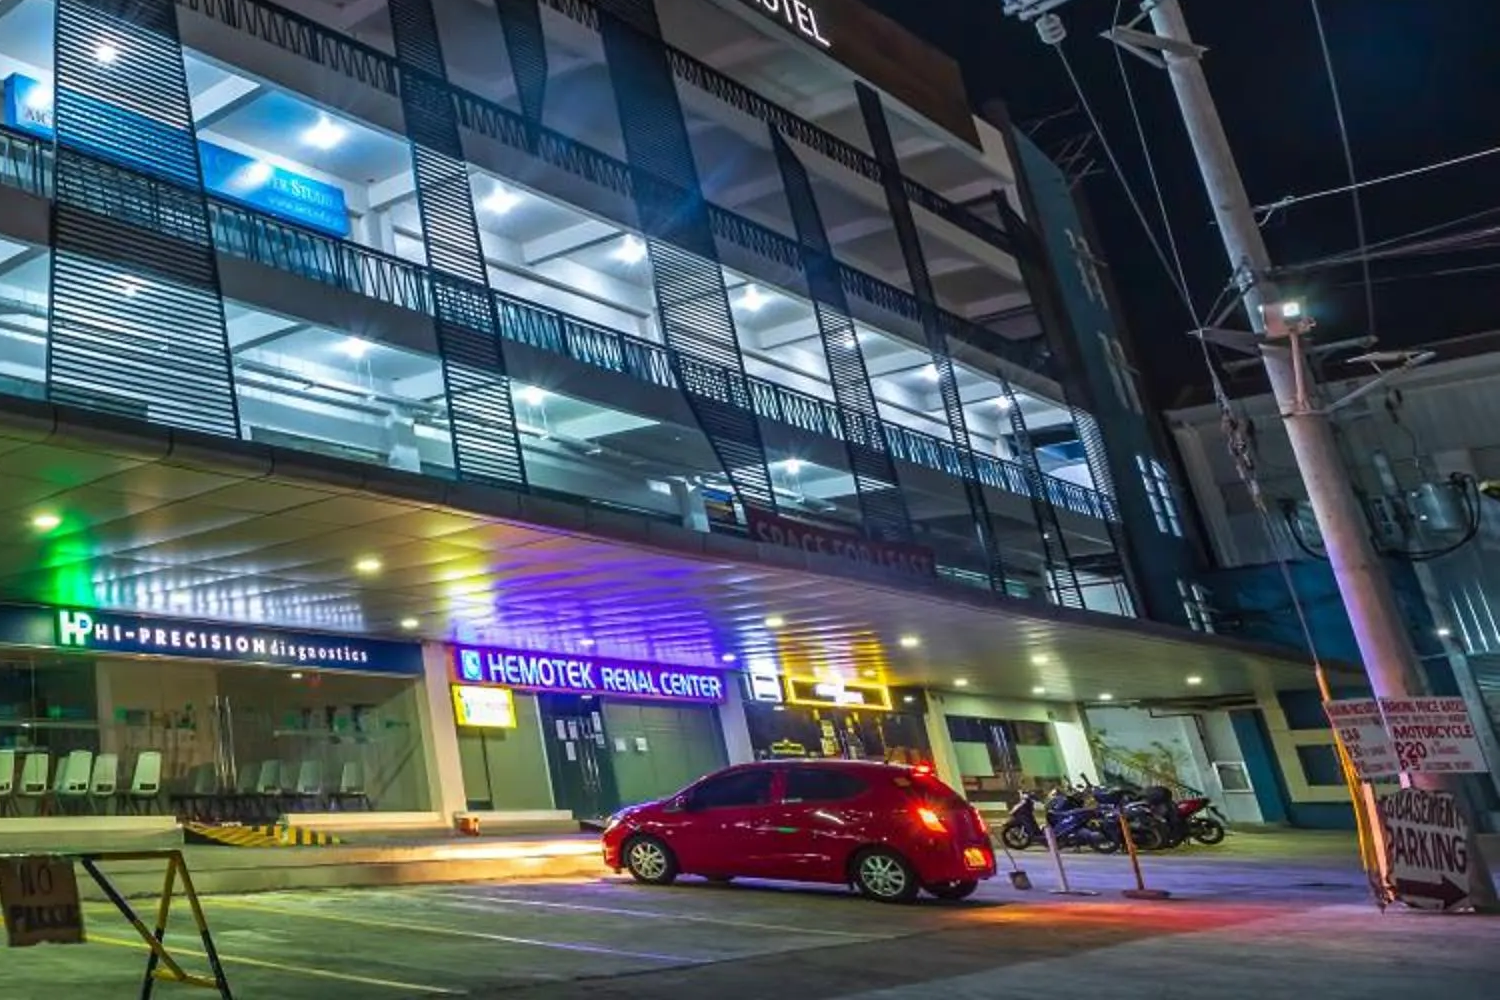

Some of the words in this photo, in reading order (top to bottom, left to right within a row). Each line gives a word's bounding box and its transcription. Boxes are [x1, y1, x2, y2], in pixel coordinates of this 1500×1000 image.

[95, 625, 267, 654] HI-PRECISION
[270, 642, 369, 664] diagnostics
[487, 653, 596, 689] HEMOTEK
[601, 667, 659, 694] RENAL
[660, 672, 723, 698] CENTER
[1392, 724, 1474, 740] MOTORCYCLE
[1384, 824, 1468, 874] PARKING
